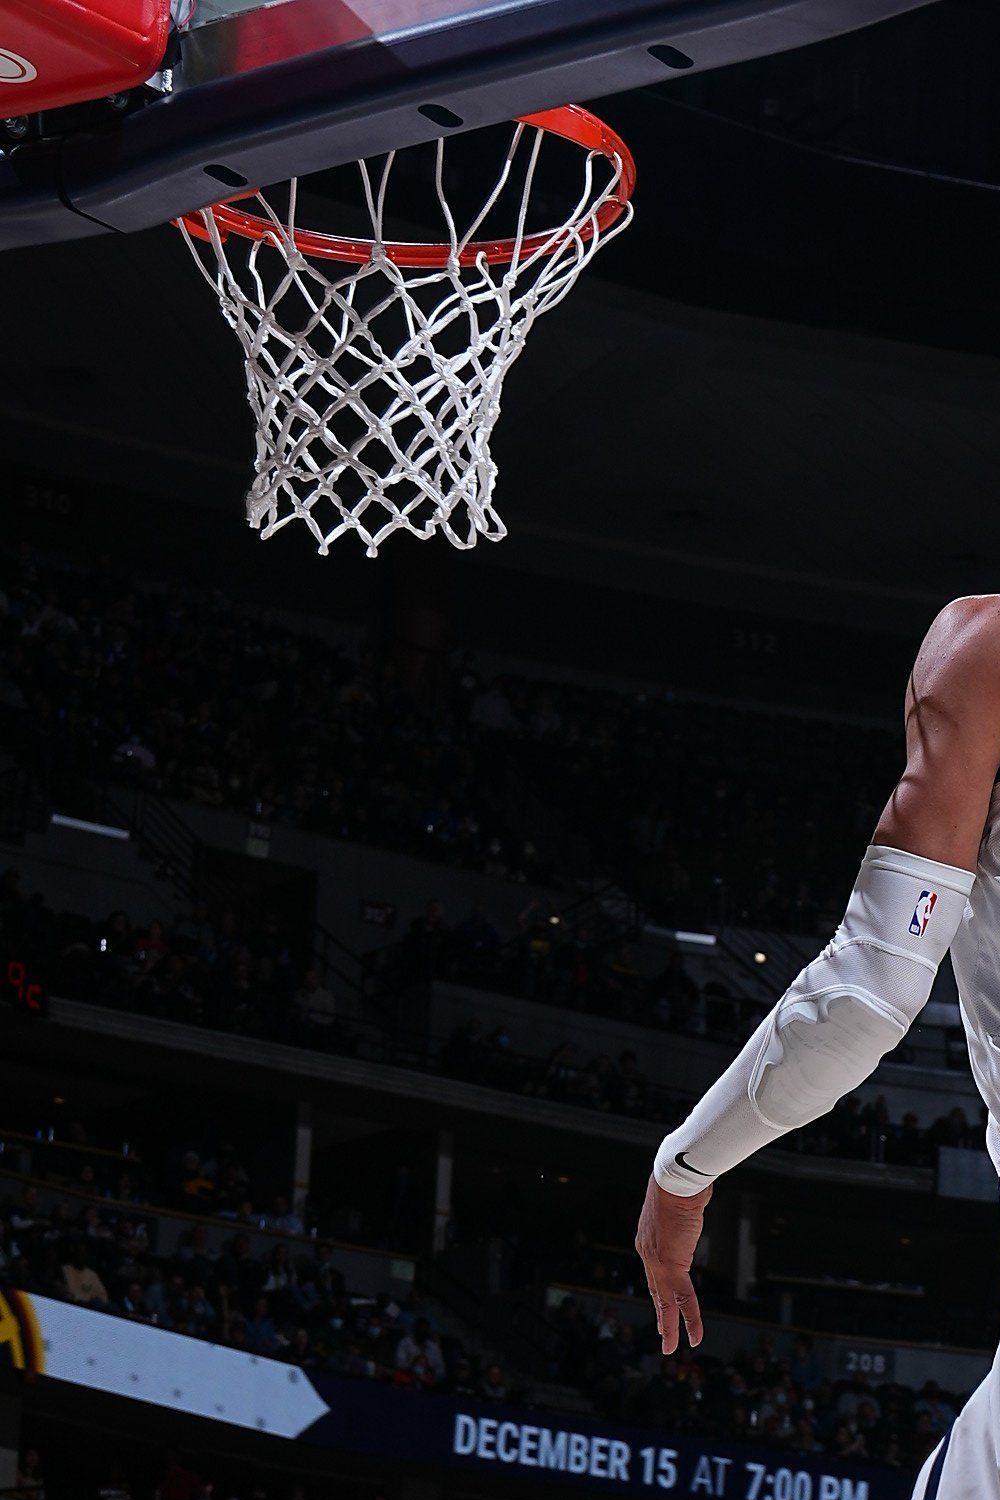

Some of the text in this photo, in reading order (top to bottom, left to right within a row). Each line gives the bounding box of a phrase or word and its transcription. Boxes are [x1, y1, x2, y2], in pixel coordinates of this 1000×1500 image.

[846, 1350, 885, 1375] 208
[453, 1413, 630, 1482] DECEMBER
[641, 1447, 678, 1488] 15
[691, 1455, 732, 1496] AT
